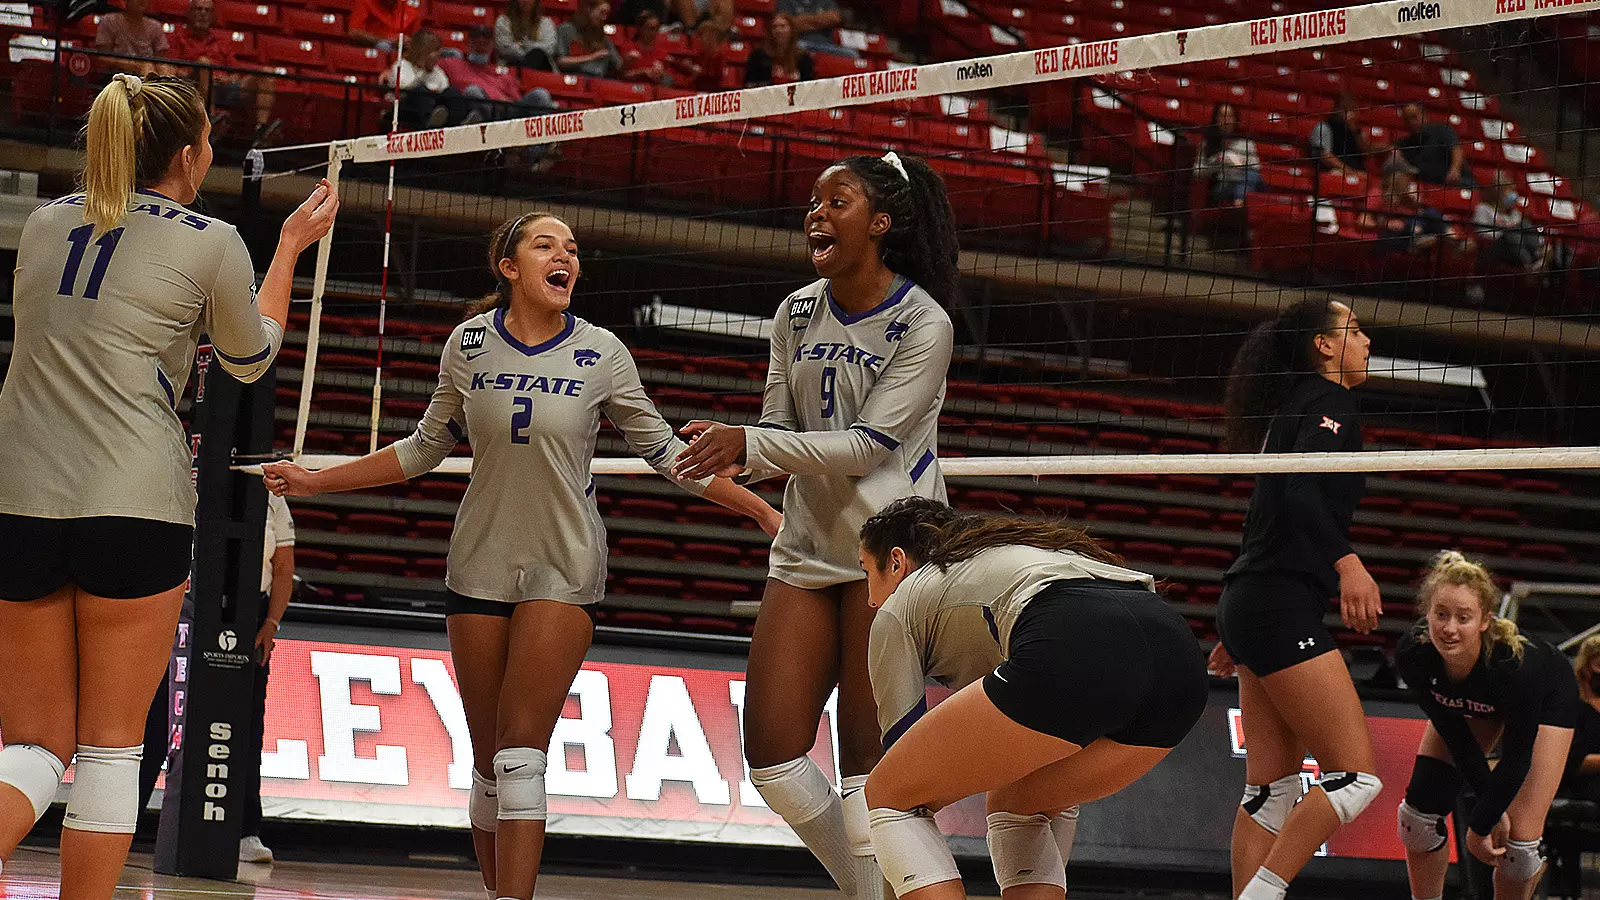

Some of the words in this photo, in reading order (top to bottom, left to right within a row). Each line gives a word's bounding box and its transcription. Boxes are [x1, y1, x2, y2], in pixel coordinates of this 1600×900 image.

[1397, 1, 1441, 23] molten
[1250, 18, 1278, 46] RED
[1282, 9, 1347, 43] RAIDERS
[956, 62, 994, 81] molten
[1034, 50, 1059, 75] RED
[1062, 41, 1119, 72] RAIDERS
[842, 76, 867, 99] RED
[869, 68, 919, 96] RAIDERS
[675, 98, 695, 120] RED
[697, 92, 741, 117] RAIDERS
[524, 114, 543, 138] RED
[545, 112, 585, 136] RAIDERS
[406, 130, 445, 153] RAIDERS
[56, 223, 126, 300] 11
[790, 300, 815, 317] BLM
[462, 330, 484, 346] BLM
[792, 342, 887, 373] K-STATE
[470, 371, 585, 398] K-STATE
[820, 366, 837, 419] 9
[510, 396, 534, 445] 2
[1466, 699, 1495, 713] TECH
[203, 721, 233, 822] senoh
